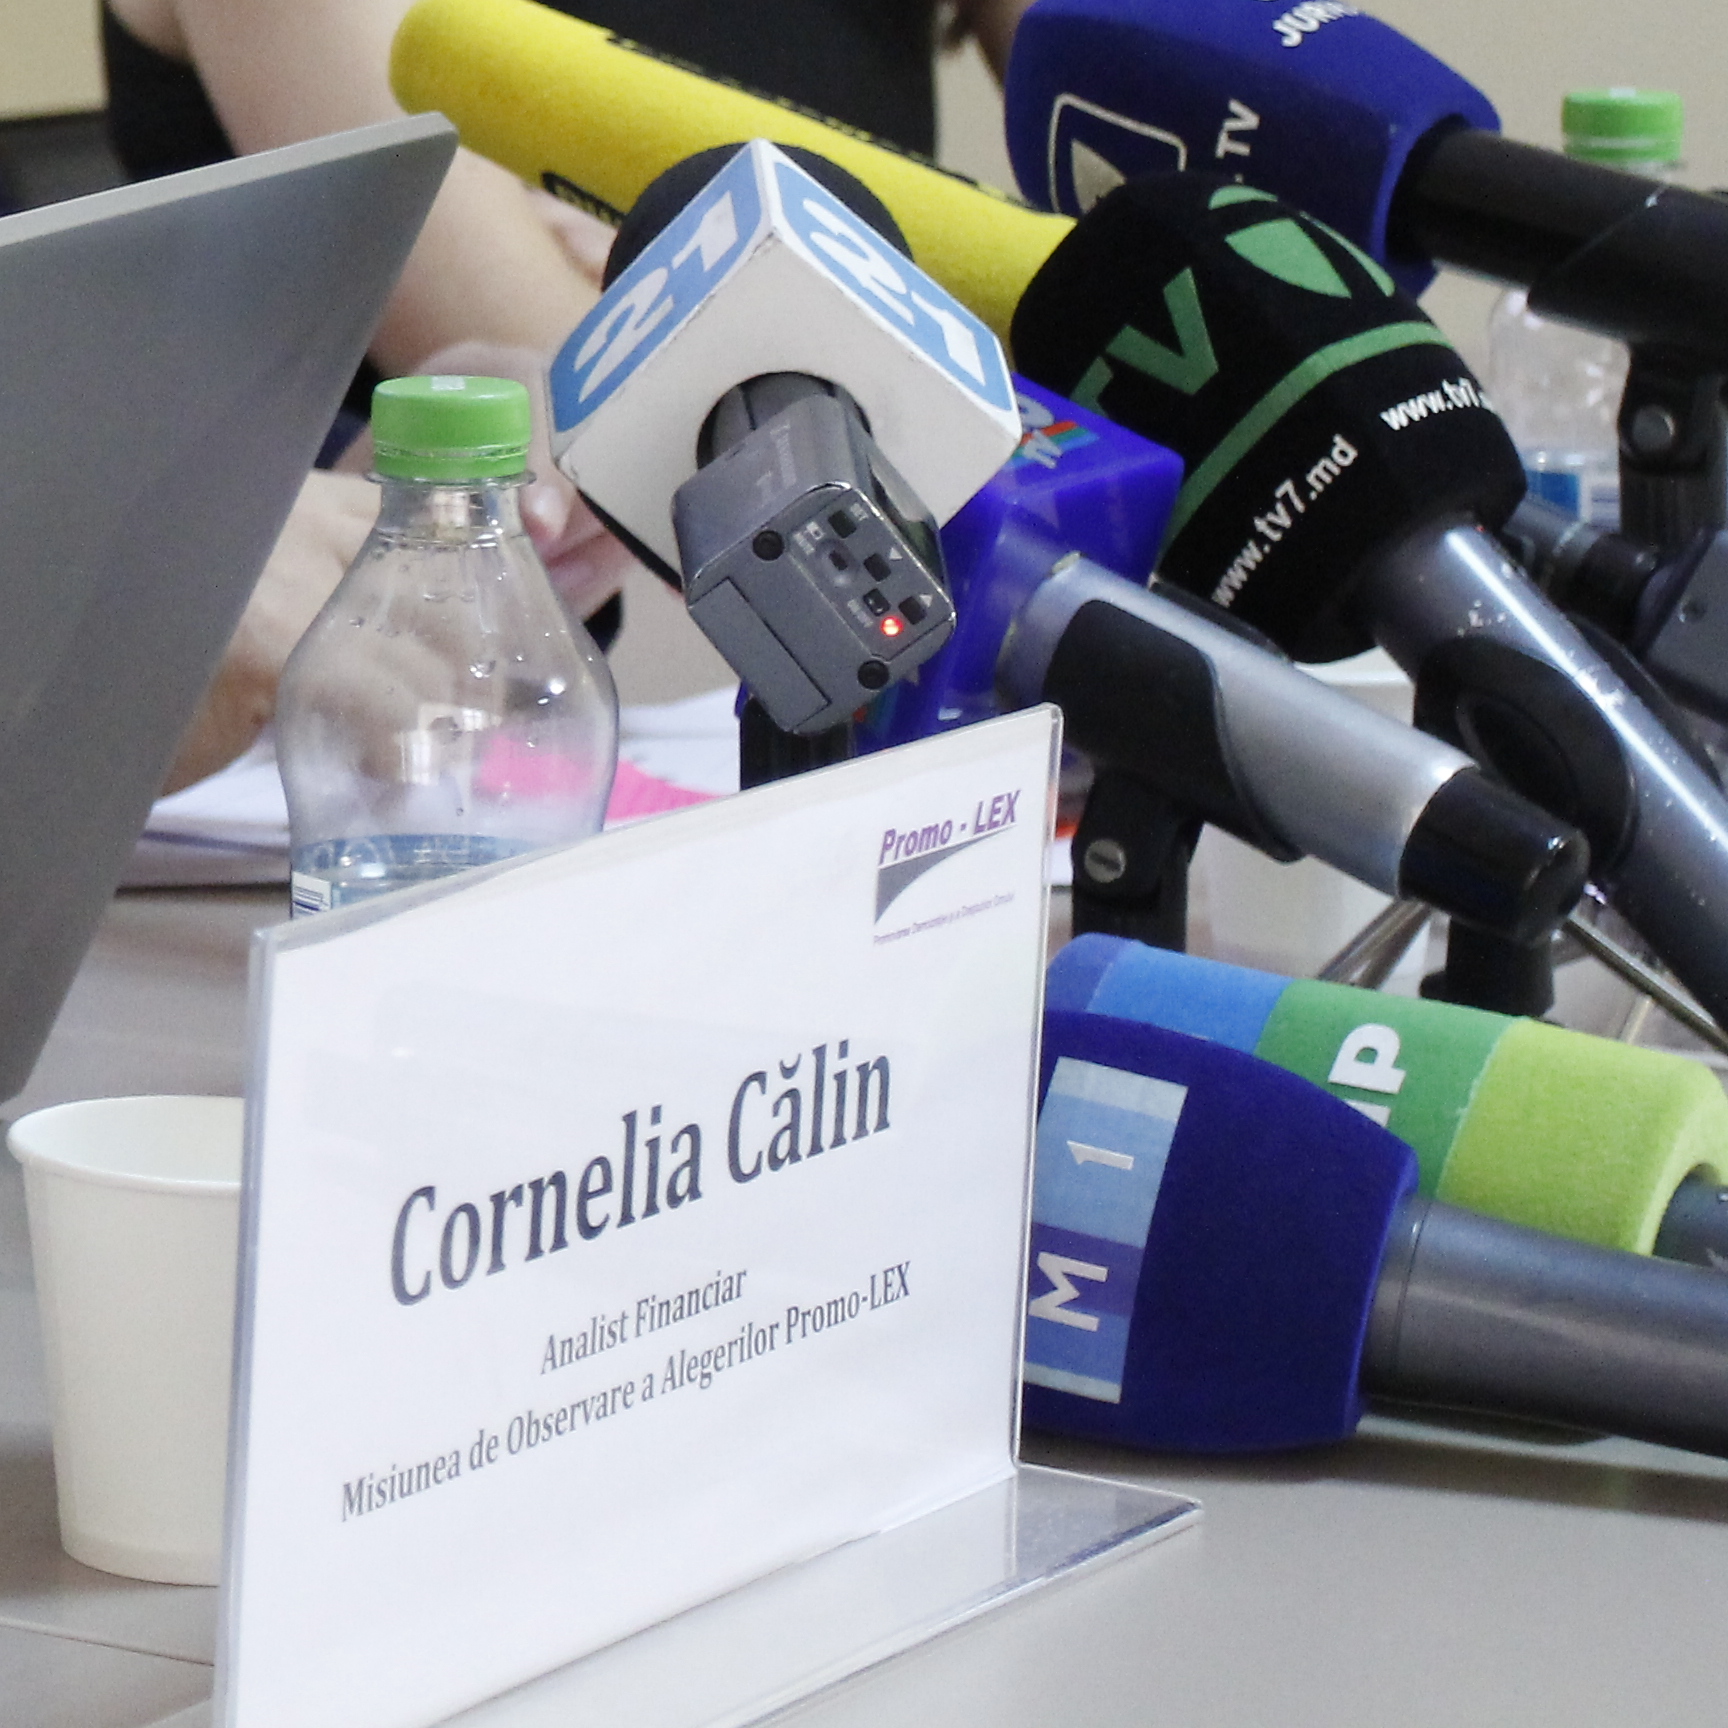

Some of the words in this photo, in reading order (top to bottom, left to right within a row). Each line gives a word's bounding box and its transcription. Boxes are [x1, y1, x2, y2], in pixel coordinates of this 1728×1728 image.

[574, 189, 740, 404] 21
[802, 197, 986, 388] 21
[1211, 433, 1359, 609] www.tv7.md
[879, 819, 953, 865] Promo
[973, 789, 1022, 835] LEX
[389, 1104, 704, 1307] Cornelia
[726, 1037, 893, 1186] Călin
[340, 1448, 462, 1523] Misiunea
[468, 1427, 501, 1471] de
[506, 1380, 636, 1457] Observare
[640, 1375, 656, 1403] a
[660, 1322, 780, 1397] Alegerilor
[784, 1260, 912, 1347] Promo-LEX
[540, 1307, 630, 1376] Analist
[634, 1267, 748, 1340] Financiar
